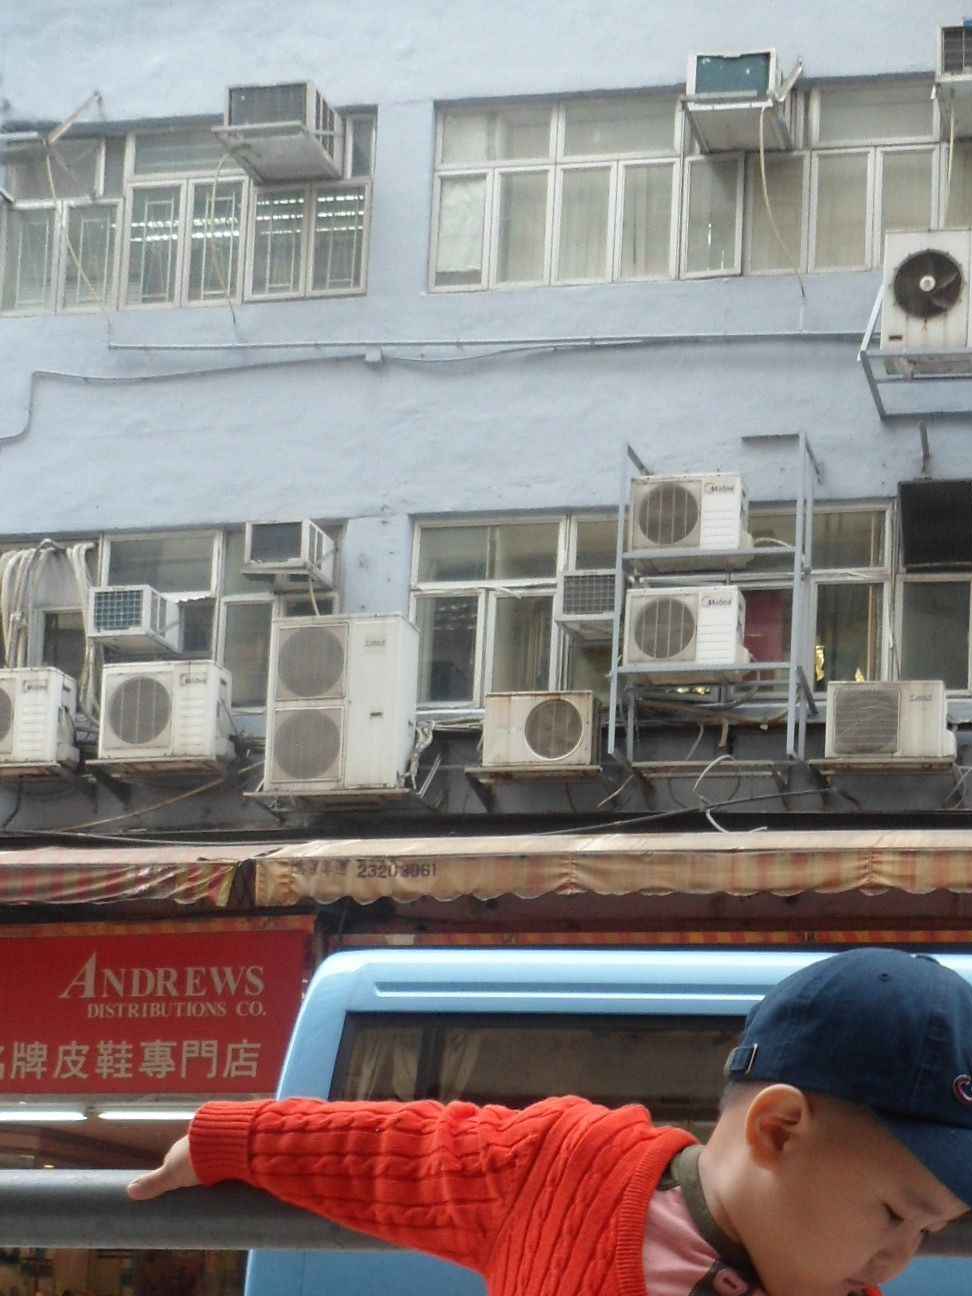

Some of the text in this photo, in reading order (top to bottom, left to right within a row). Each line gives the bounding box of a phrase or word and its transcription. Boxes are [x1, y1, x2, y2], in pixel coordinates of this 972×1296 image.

[58, 951, 265, 998] ANDREWS
[87, 1001, 268, 1018] DISTRIBUTIONS CO.
[0, 1038, 262, 1080] 牌皮鞋專門店
